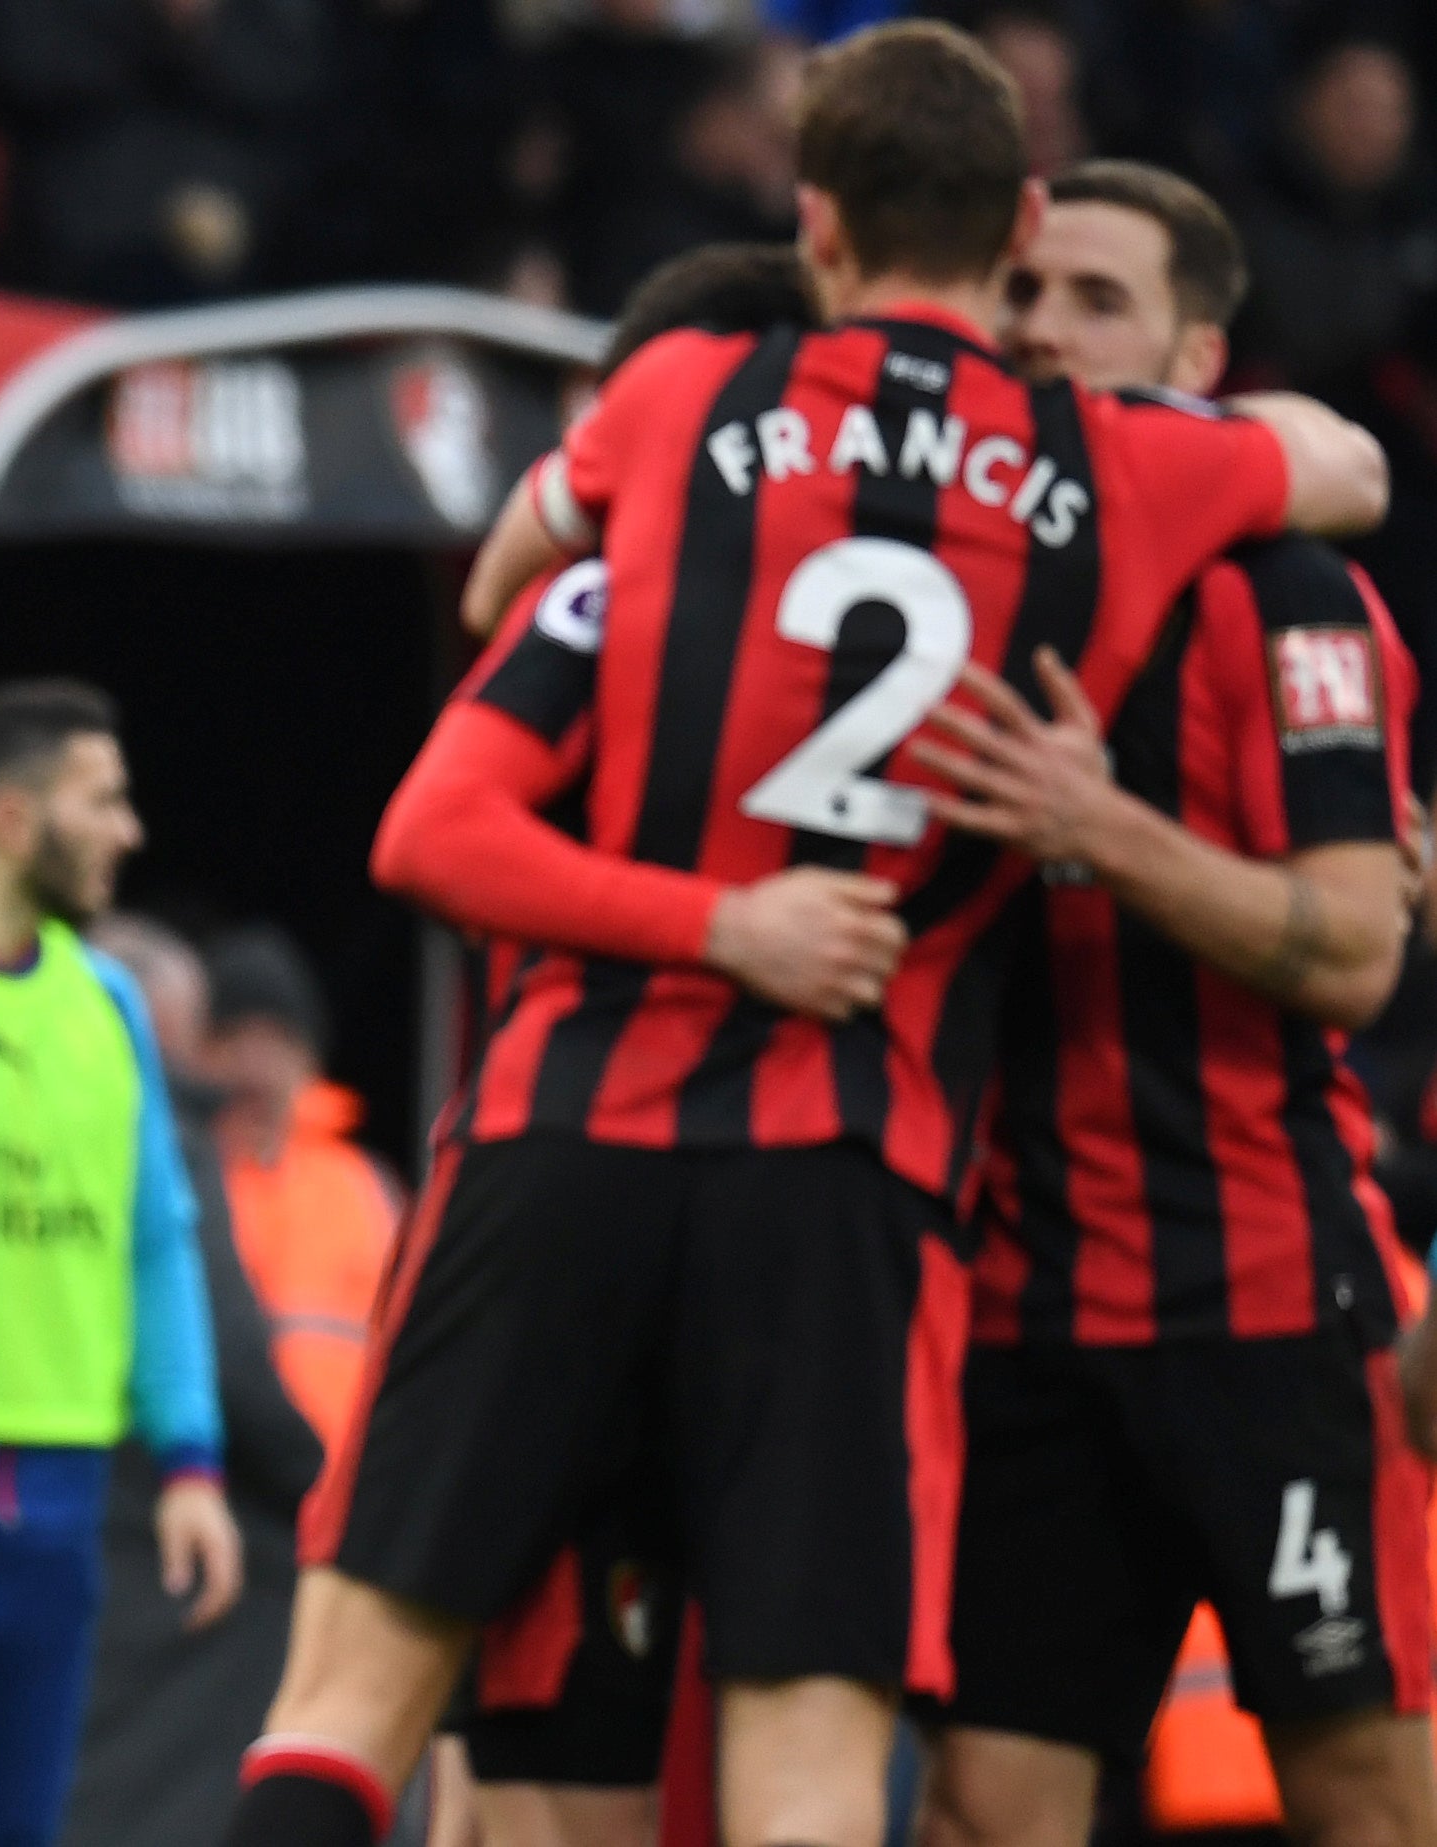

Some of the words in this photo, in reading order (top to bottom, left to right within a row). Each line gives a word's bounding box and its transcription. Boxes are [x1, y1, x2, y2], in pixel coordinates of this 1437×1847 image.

[706, 403, 1090, 547] FRANCIS
[737, 535, 973, 847] 2
[1266, 1476, 1354, 1617] 4
